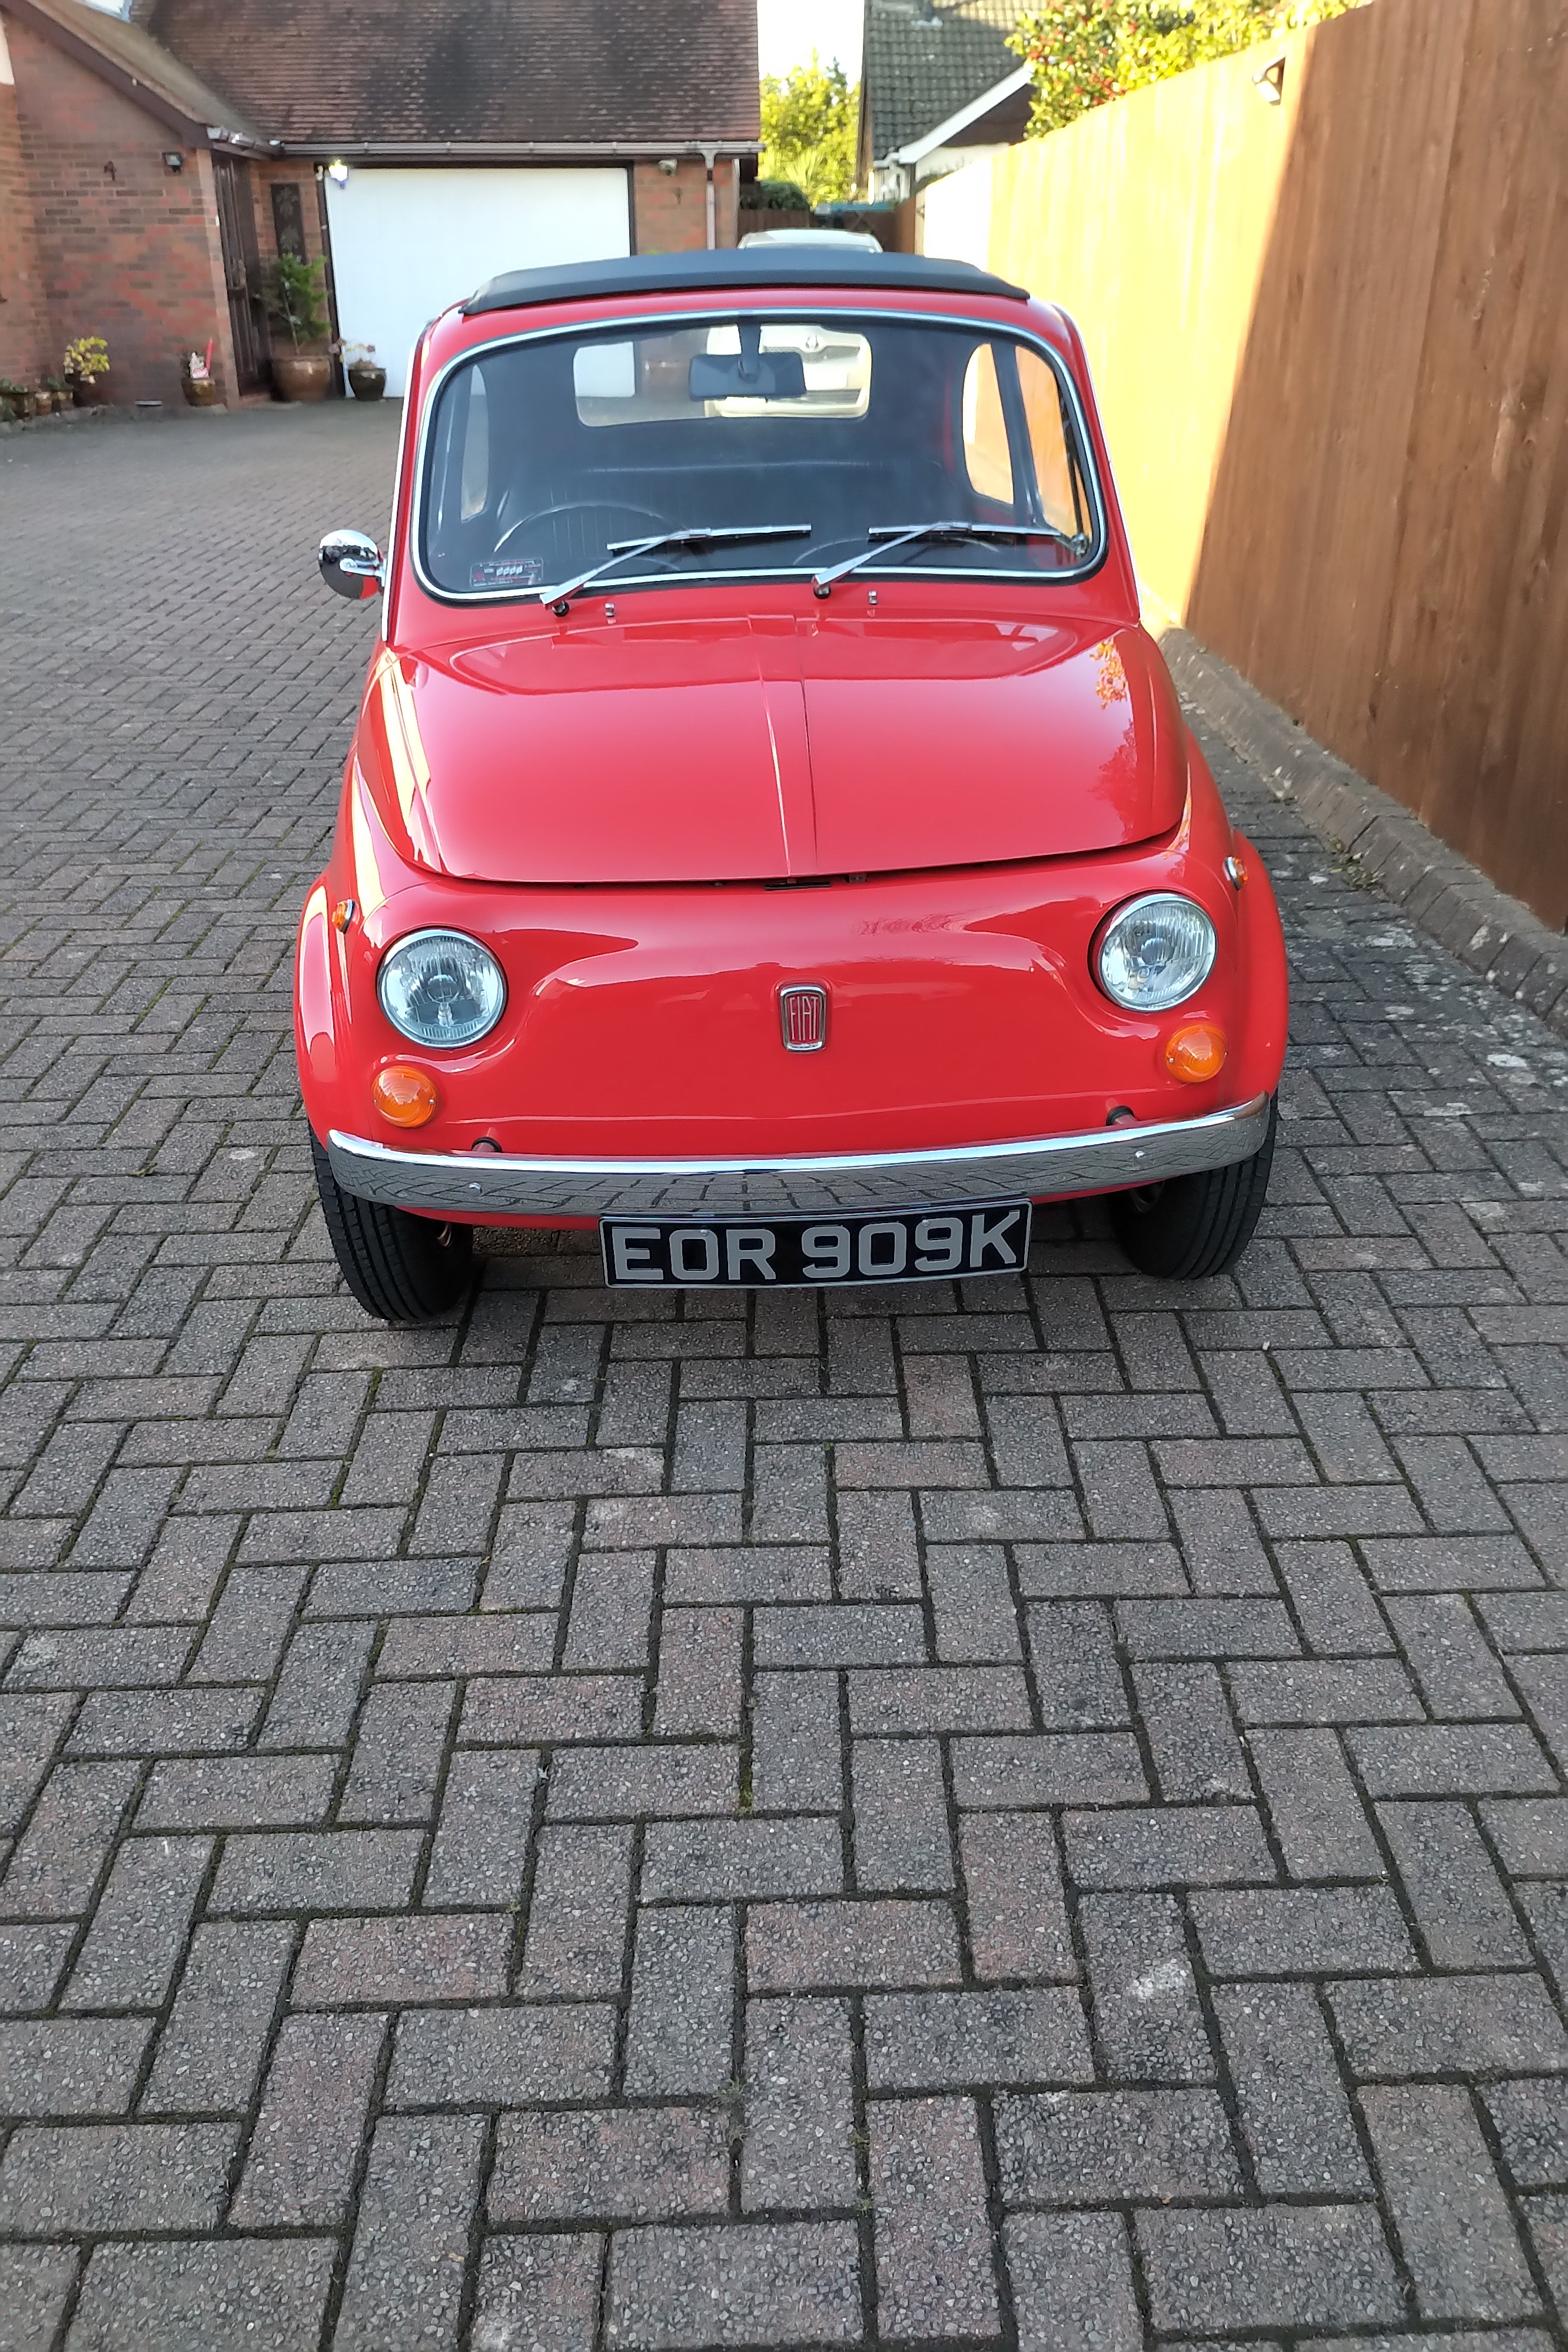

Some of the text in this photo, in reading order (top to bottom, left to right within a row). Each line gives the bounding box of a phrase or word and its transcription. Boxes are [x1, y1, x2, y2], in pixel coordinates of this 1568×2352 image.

[789, 996, 819, 1041] FIAT
[611, 1210, 1021, 1281] EOR 909K
